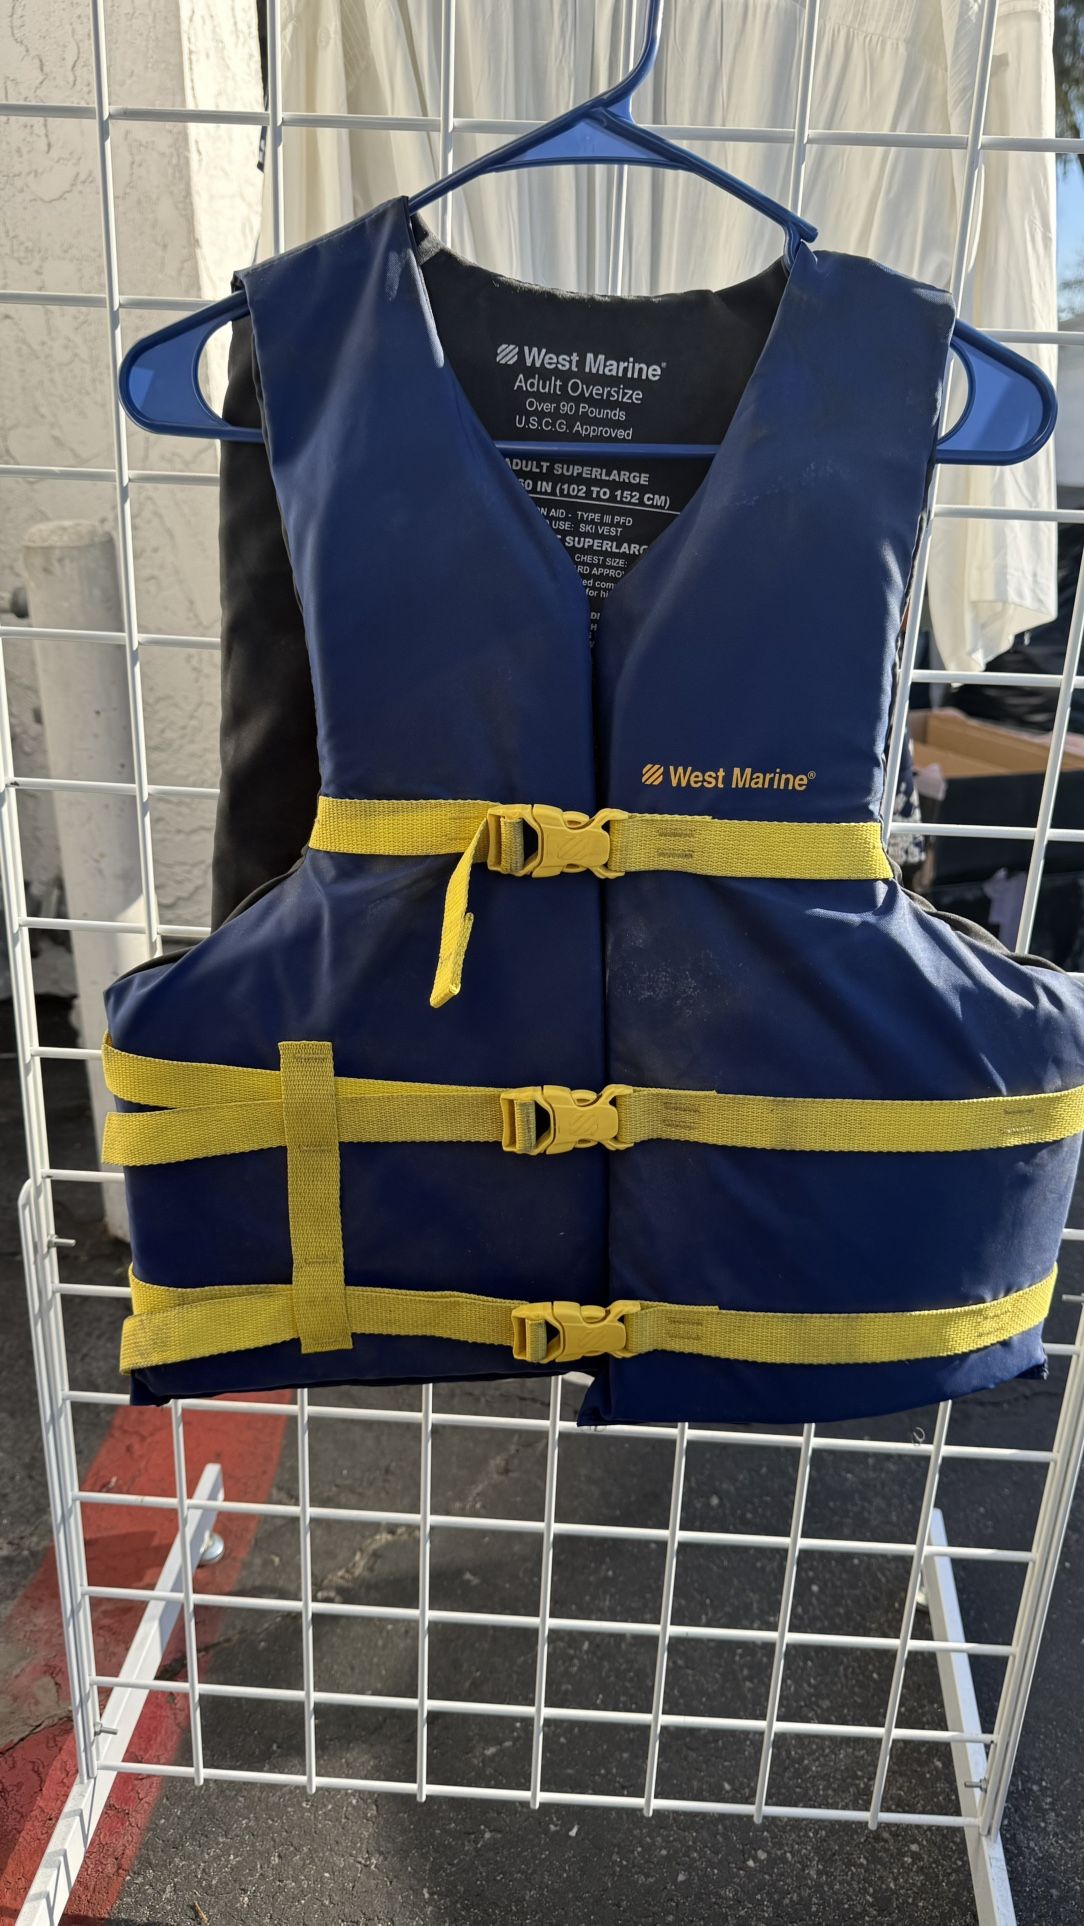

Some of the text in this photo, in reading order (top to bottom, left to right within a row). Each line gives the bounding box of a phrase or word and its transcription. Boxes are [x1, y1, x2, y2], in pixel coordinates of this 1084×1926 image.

[524, 346, 579, 371] West
[514, 374, 643, 404] Adult Oversize
[526, 398, 626, 421] Over 90 Pounds
[515, 415, 633, 440] U.S.C.G. Approved
[553, 463, 650, 485] SUPERLARGE
[537, 481, 552, 493] IN
[556, 483, 587, 496] (102
[590, 487, 610, 500] TO
[615, 490, 639, 503] 152
[643, 494, 671, 510] CM)
[550, 508, 566, 518] AID
[576, 511, 601, 522] TYPE
[603, 514, 612, 524] III
[614, 515, 633, 526] PFD
[552, 521, 575, 531] USE:
[579, 523, 595, 533] SKI
[597, 525, 623, 537] VEST
[575, 553, 628, 568] CHEST SIZE:
[576, 565, 624, 578] RD APPRO
[669, 765, 725, 788] West
